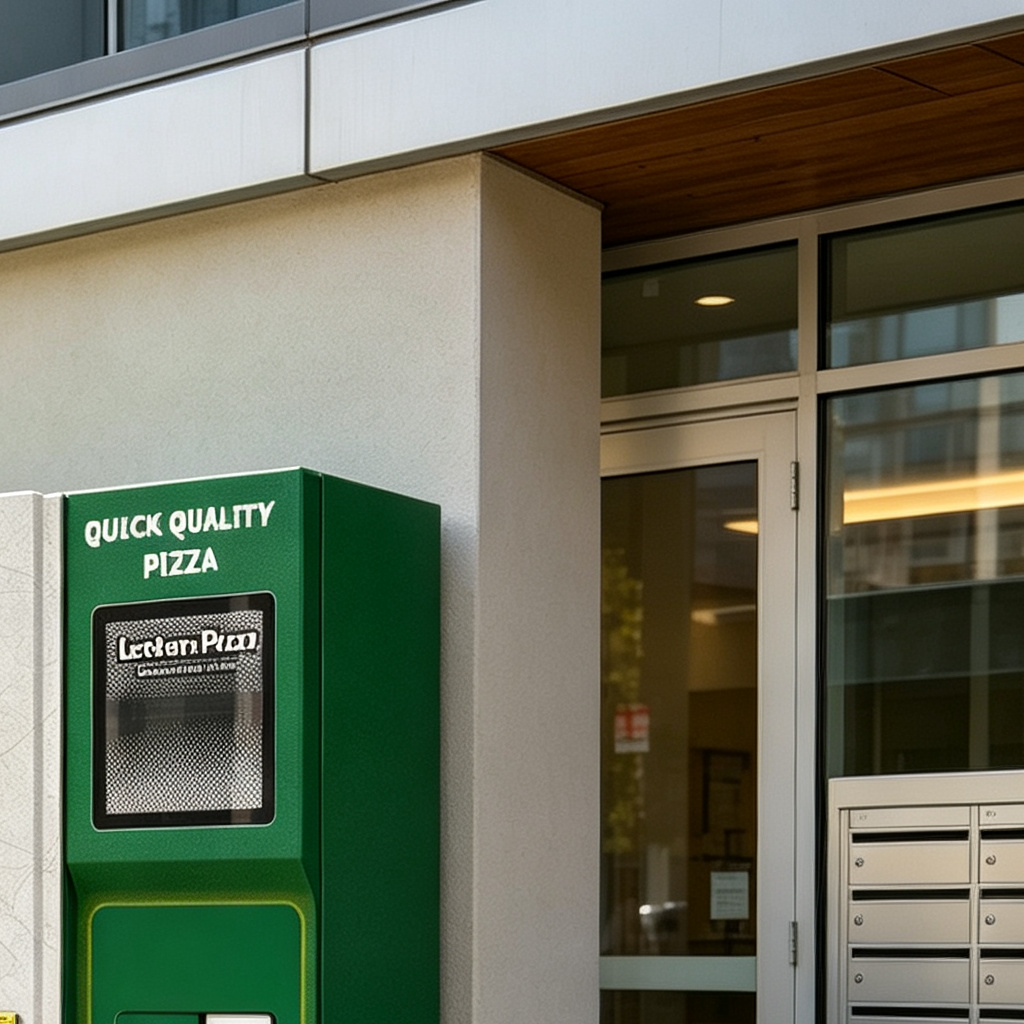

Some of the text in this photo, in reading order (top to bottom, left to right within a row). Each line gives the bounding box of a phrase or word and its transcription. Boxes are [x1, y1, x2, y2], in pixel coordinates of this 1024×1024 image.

[84, 501, 276, 548] QUICK QUALITY
[143, 546, 219, 580] PIZZA
